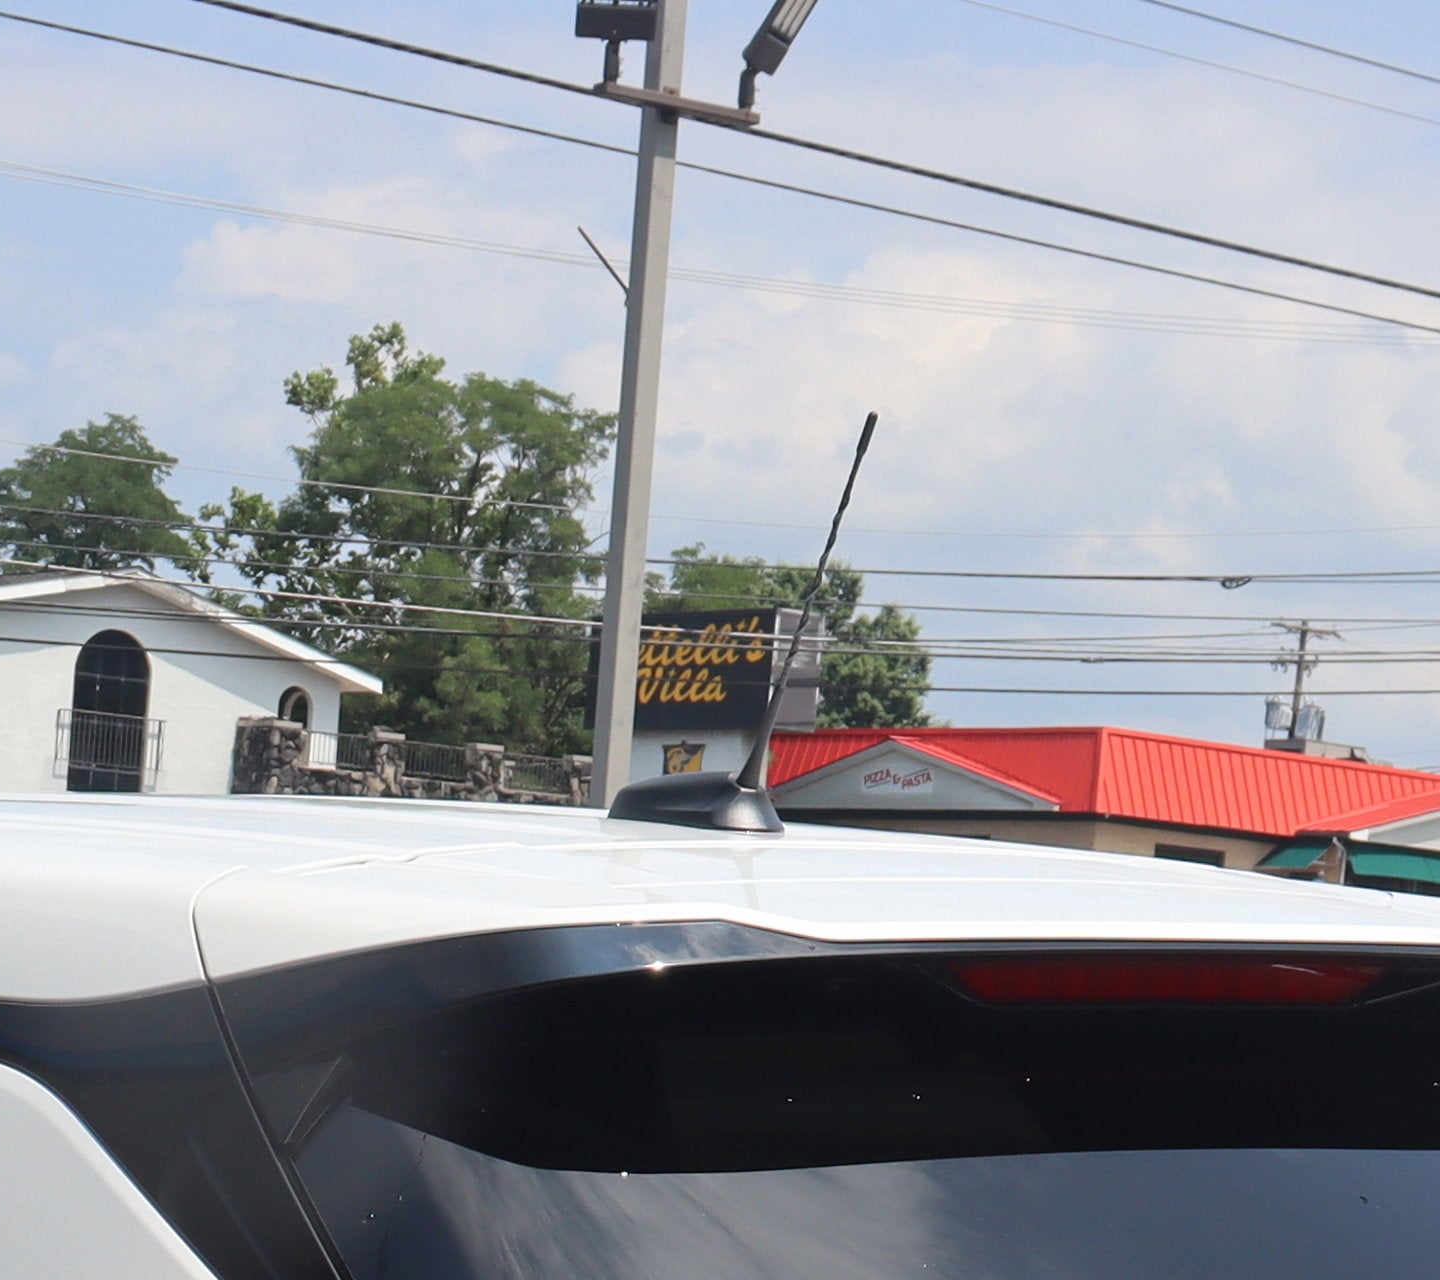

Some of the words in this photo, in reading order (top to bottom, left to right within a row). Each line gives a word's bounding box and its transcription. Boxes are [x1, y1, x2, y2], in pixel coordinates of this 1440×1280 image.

[638, 667, 727, 704] Villa
[864, 768, 892, 787] PIZZA
[901, 772, 933, 790] PASTA
